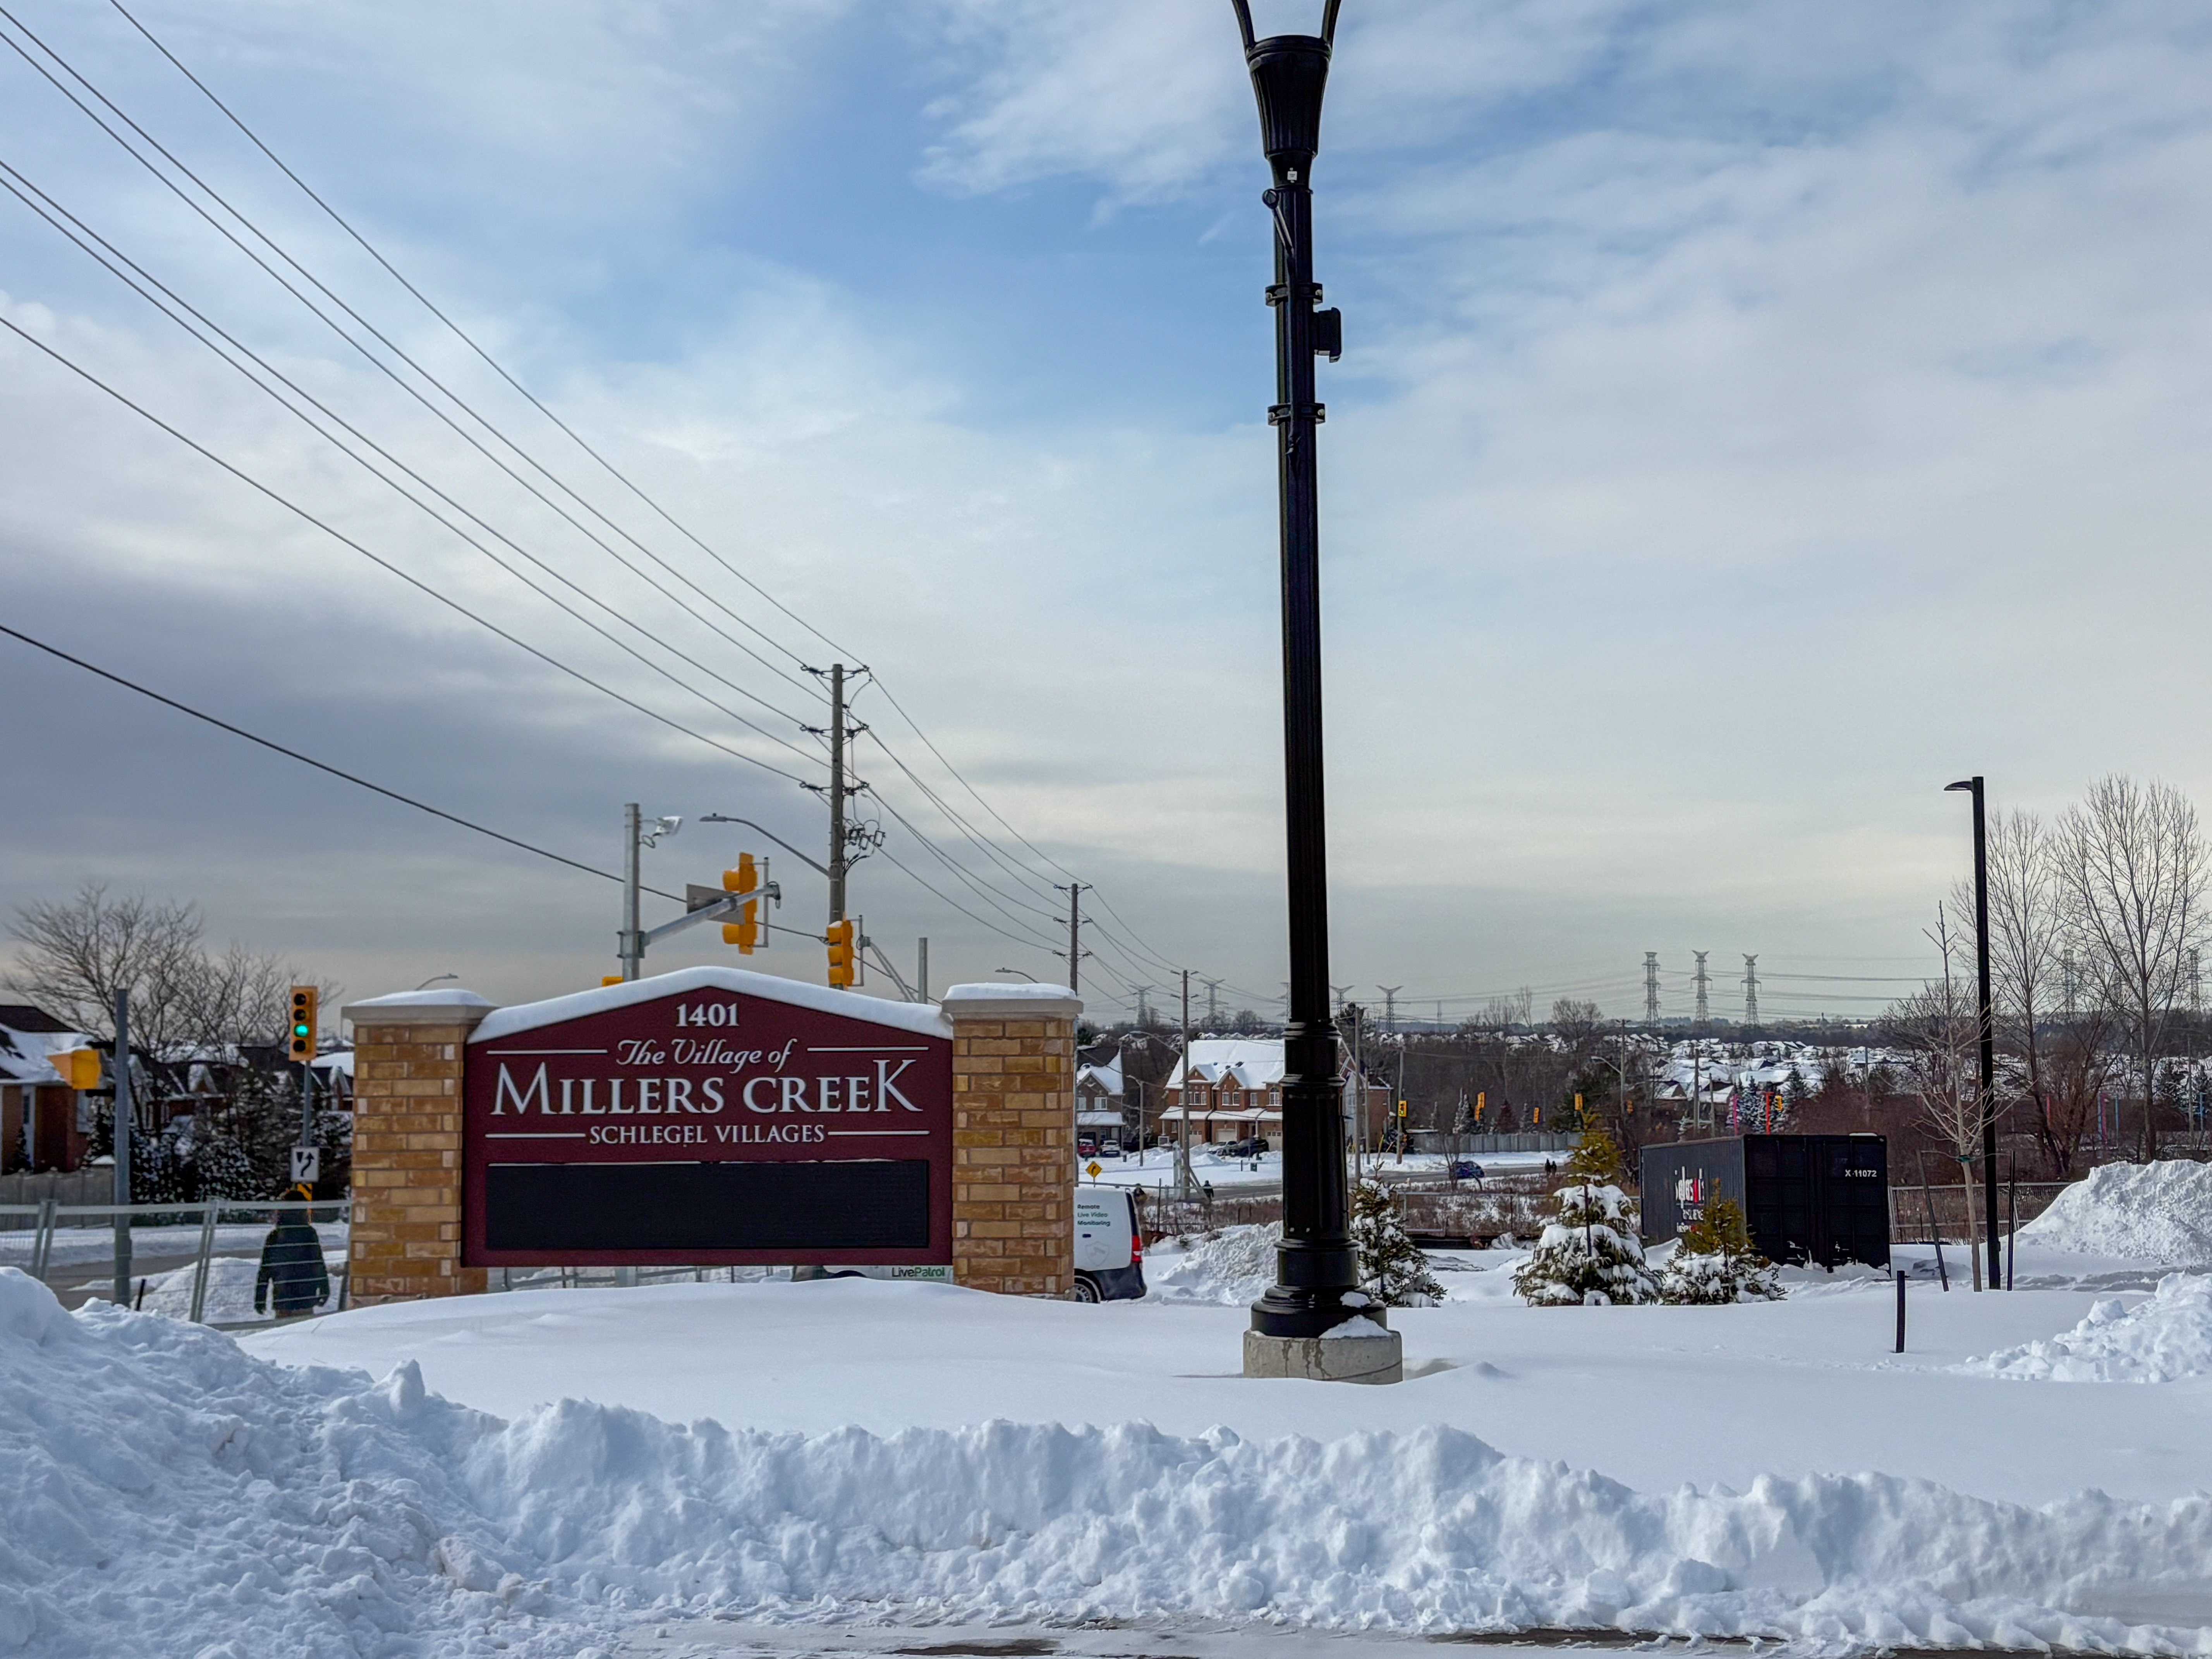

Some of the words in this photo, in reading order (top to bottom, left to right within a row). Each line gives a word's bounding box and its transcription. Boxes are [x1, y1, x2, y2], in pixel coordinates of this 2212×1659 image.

[676, 1003, 740, 1027] 1401
[616, 1039, 666, 1065] The
[671, 1039, 761, 1074] Village
[768, 1038, 798, 1073] of
[489, 1061, 725, 1115] MILLERS
[742, 1059, 924, 1114] CREEK
[589, 1125, 708, 1144] SCHLEGEL
[715, 1124, 825, 1143] VILLAGES
[891, 1267, 945, 1277] LivePatrol
